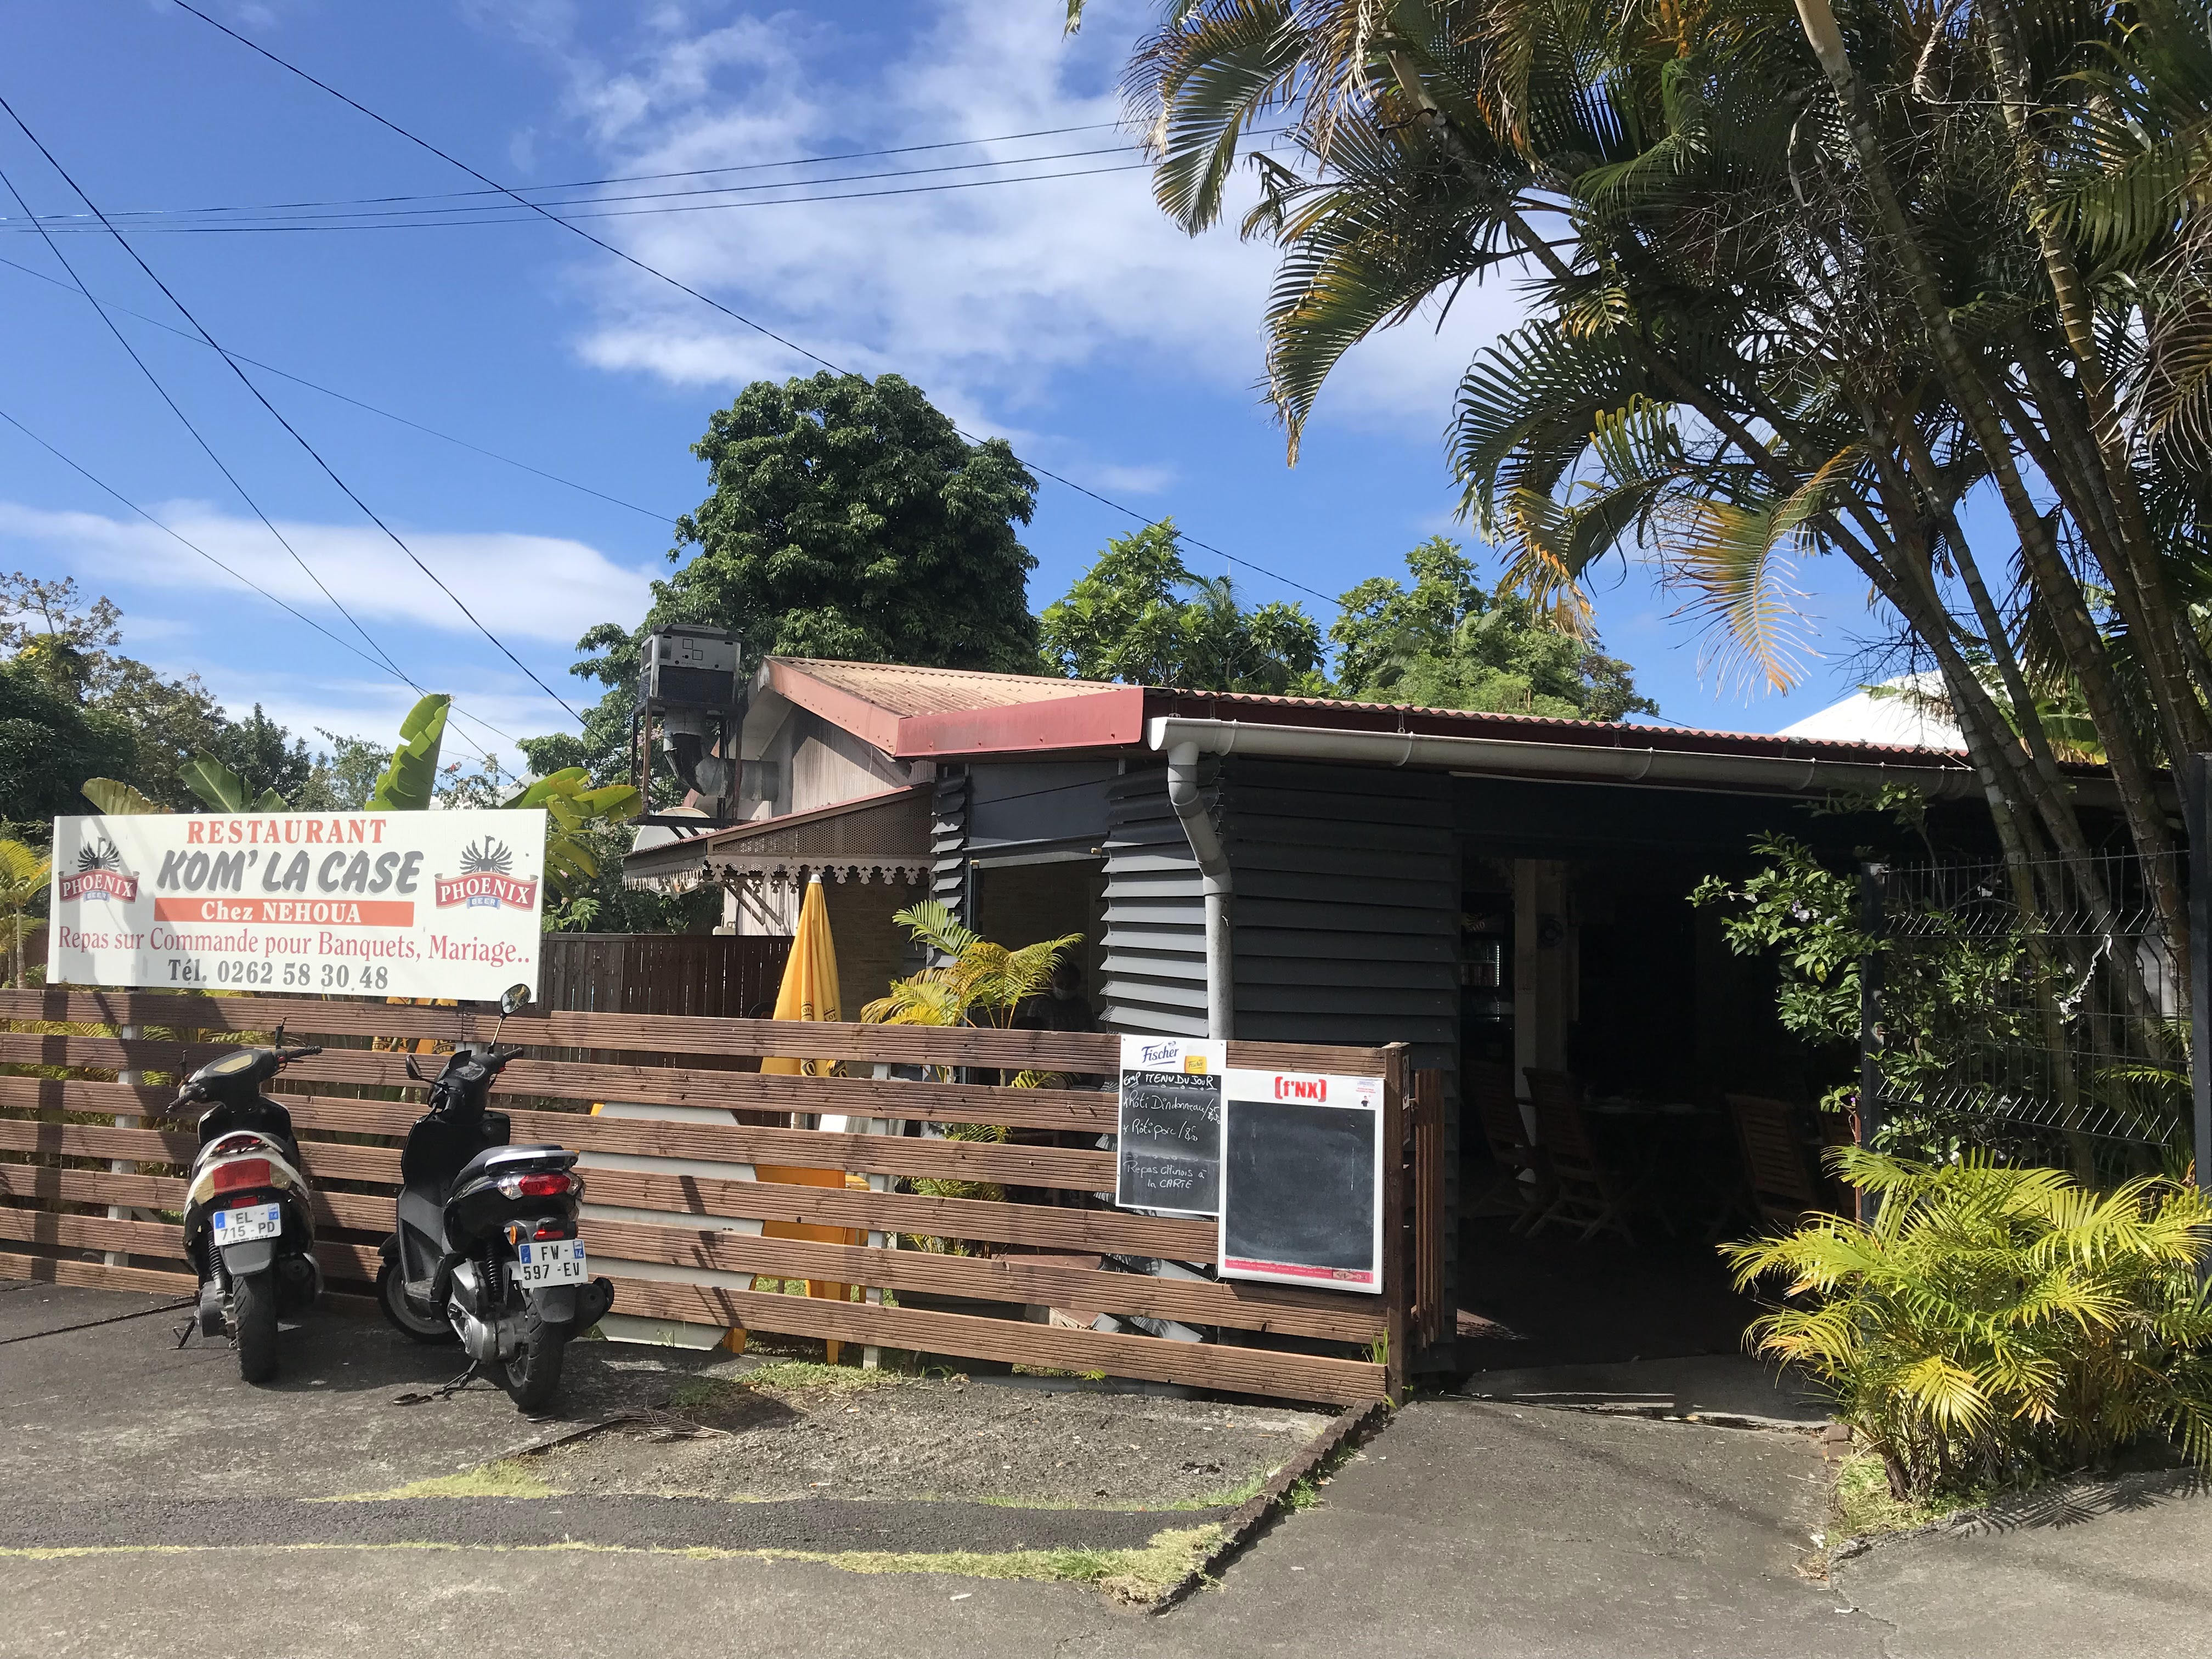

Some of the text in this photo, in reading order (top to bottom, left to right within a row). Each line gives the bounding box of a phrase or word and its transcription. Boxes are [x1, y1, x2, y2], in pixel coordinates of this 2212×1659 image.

[187, 819, 387, 844] RESTAURANT
[156, 849, 425, 895] KOM' LA CASE
[62, 873, 133, 898] PHOENIX
[440, 877, 530, 905] PHOENIX
[201, 900, 362, 923] Chez NEHOUA
[58, 926, 109, 953] Repas
[114, 932, 145, 950] sur
[150, 927, 258, 953] Commande
[264, 936, 312, 958] pour
[318, 931, 421, 963] Banquets,
[167, 958, 388, 990] Tél. 0262 58 30 48
[1141, 1041, 1179, 1064] Fischer
[1175, 1075, 1189, 1085] DU
[1154, 1125, 1176, 1140] porc
[1123, 1160, 1158, 1178] Repas
[1148, 1179, 1193, 1188] la CARTE
[235, 1212, 253, 1224] EL
[221, 1226, 246, 1240] 715
[258, 1221, 275, 1234] PD
[541, 1245, 559, 1261] FW
[523, 1264, 550, 1281] 597
[563, 1262, 579, 1277] EV
